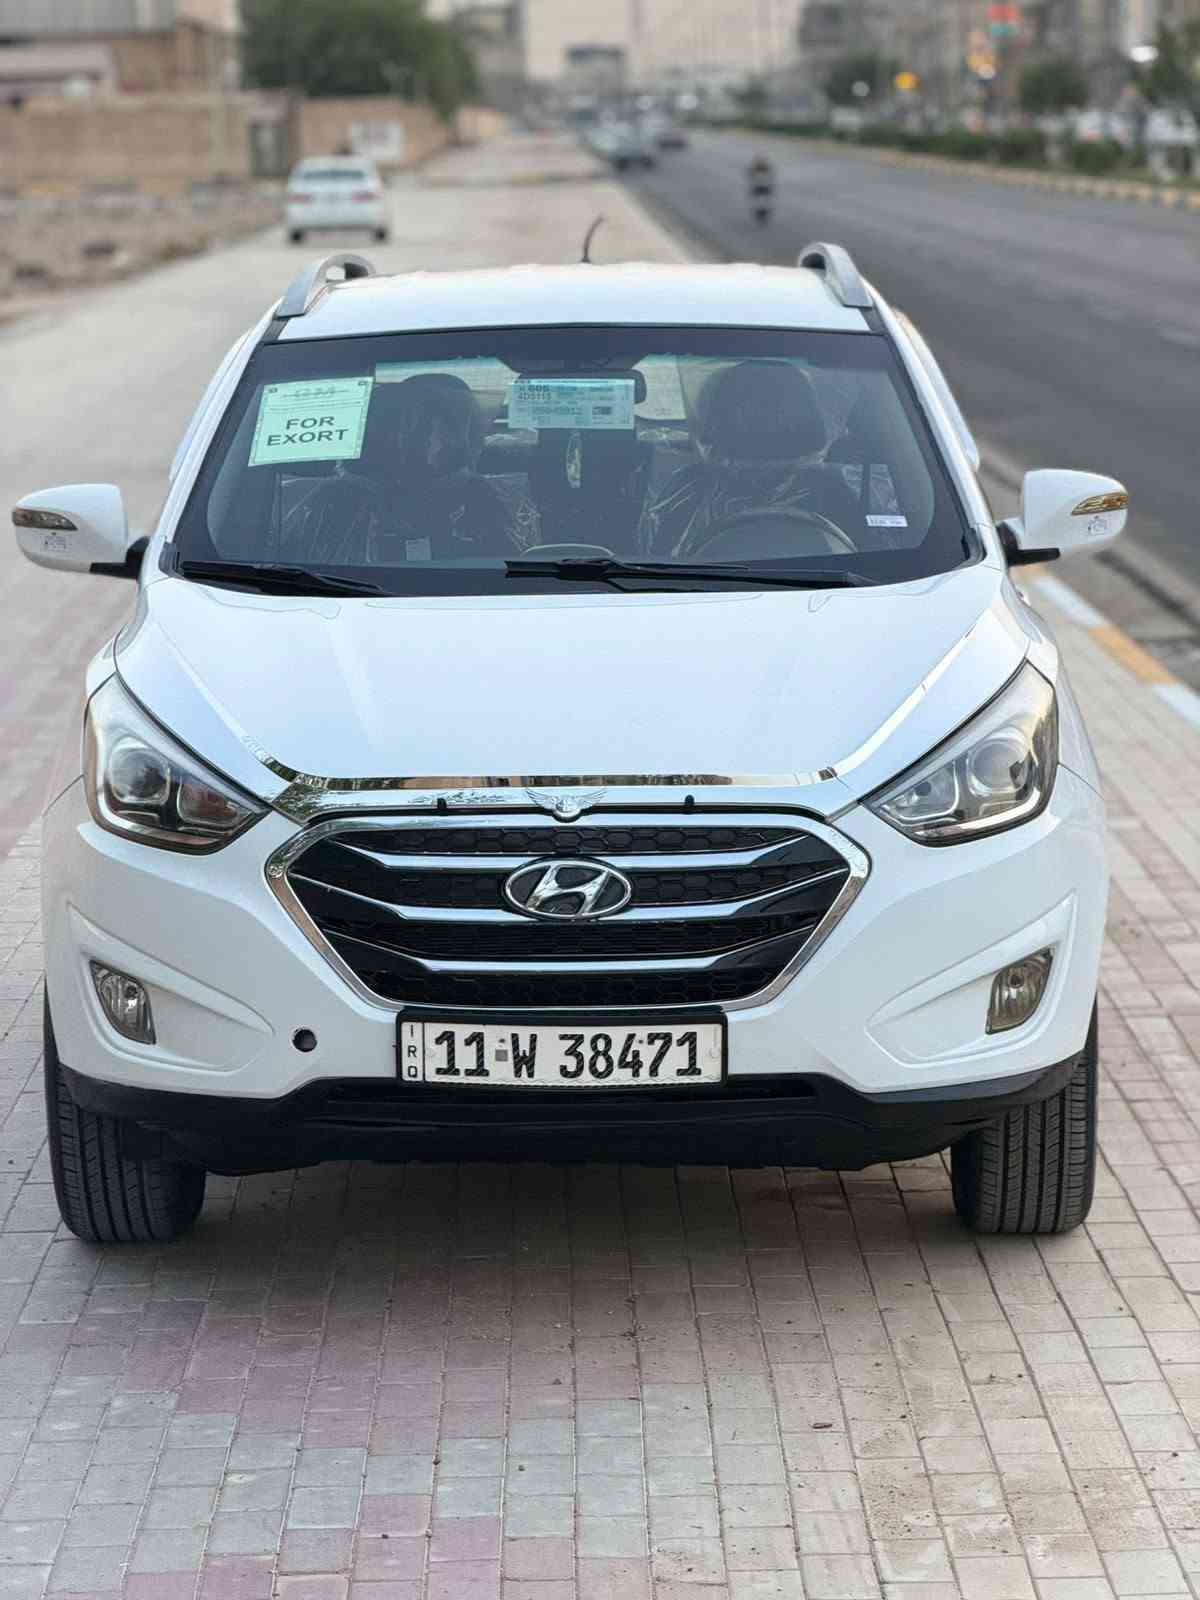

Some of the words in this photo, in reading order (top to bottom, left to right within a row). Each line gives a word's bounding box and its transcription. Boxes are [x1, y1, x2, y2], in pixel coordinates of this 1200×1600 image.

[286, 416, 335, 430] FOR
[266, 428, 349, 446] EXORT
[434, 1030, 490, 1077] 11
[510, 1032, 538, 1078] W
[558, 1031, 702, 1079] 38471
